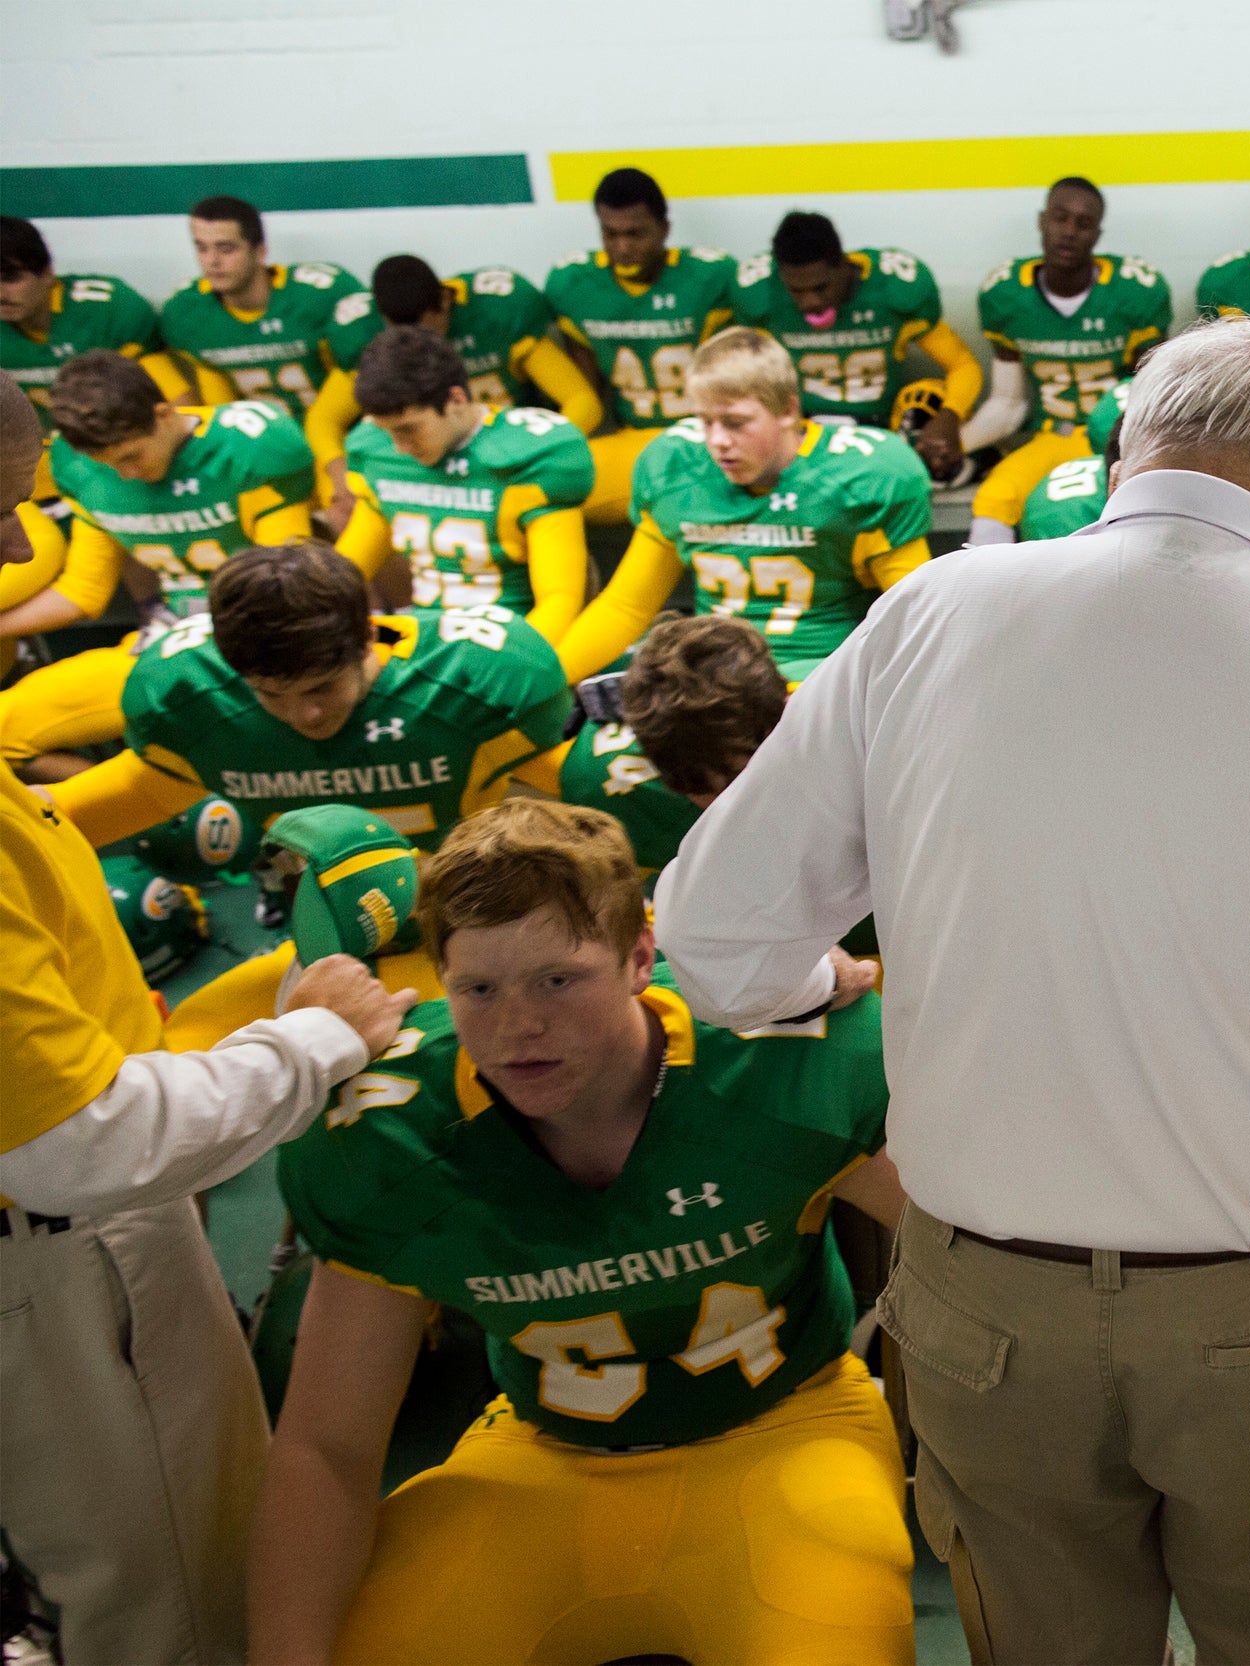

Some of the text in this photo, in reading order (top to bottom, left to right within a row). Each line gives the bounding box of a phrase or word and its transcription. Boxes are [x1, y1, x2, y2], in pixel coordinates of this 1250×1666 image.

[679, 521, 817, 548] SUMMERVILLE
[221, 755, 452, 800] SUMMERVILLE
[464, 1219, 773, 1304] SUMMERVILLE
